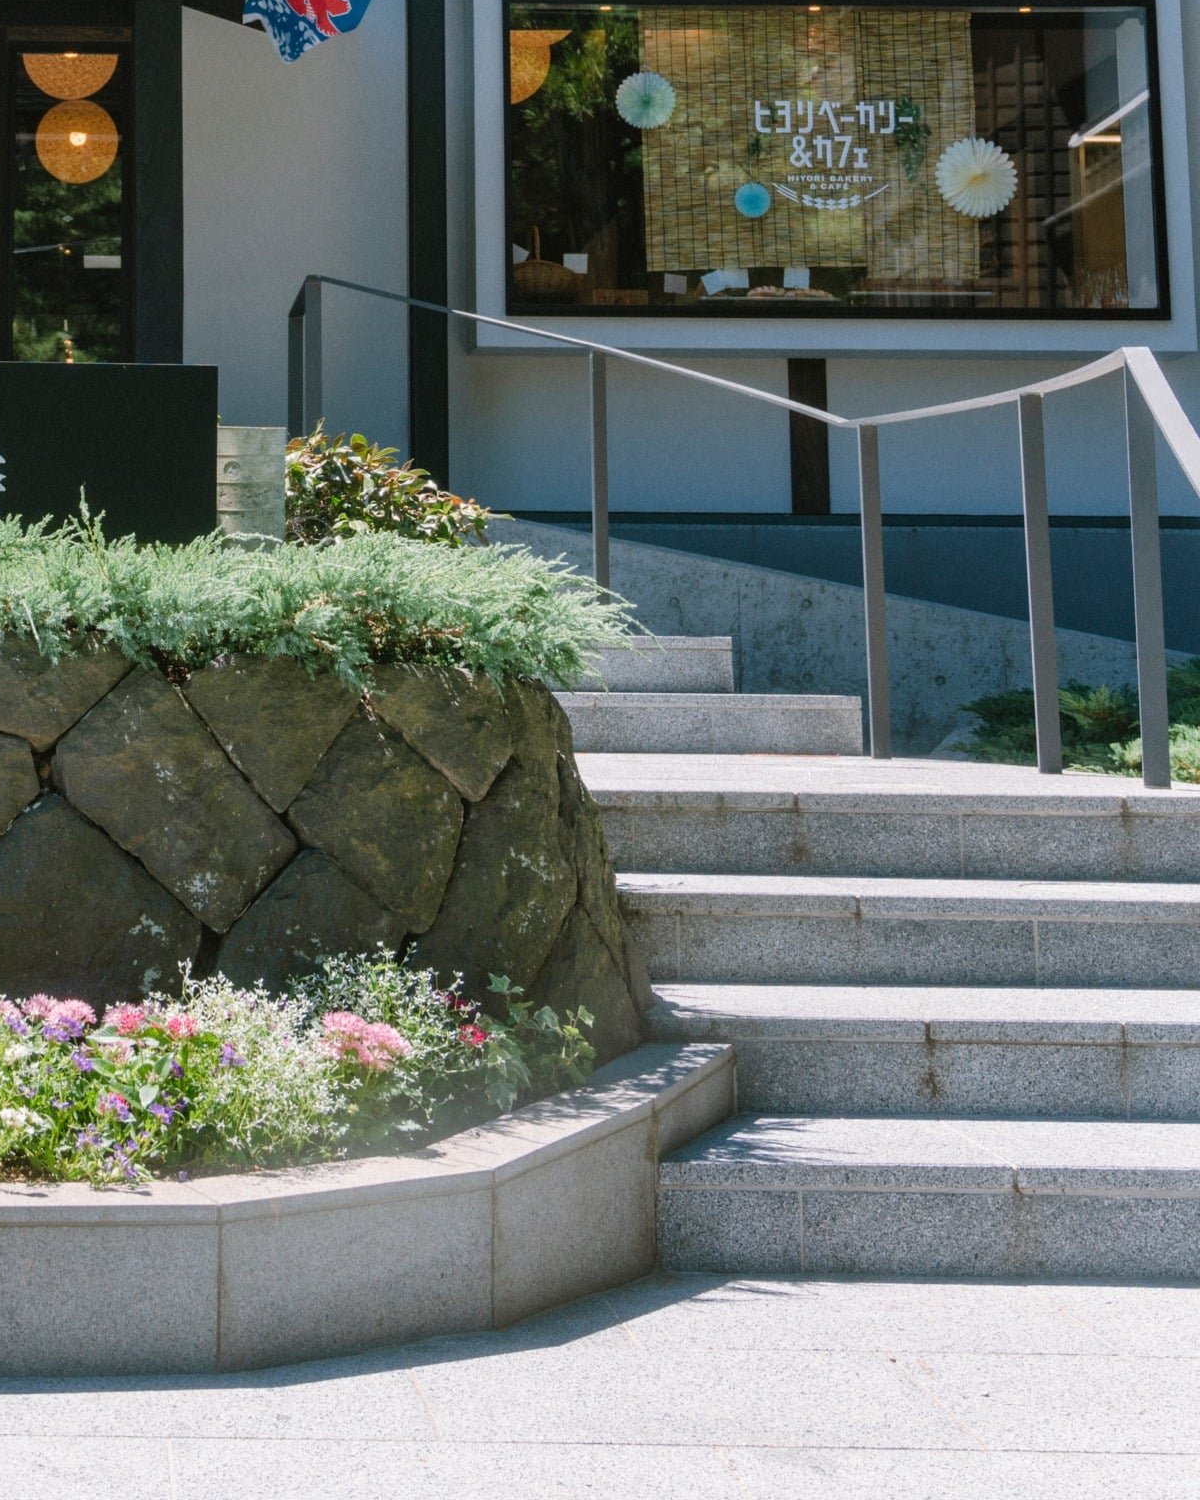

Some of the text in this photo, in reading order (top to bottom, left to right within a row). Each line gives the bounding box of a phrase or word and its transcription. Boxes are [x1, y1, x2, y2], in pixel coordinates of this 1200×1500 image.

[754, 100, 914, 134] ヒヨリベーカリー
[789, 135, 869, 169] &カフェ
[787, 175, 873, 183] HIYORI BAKERY
[820, 182, 850, 190] CAFÉ
